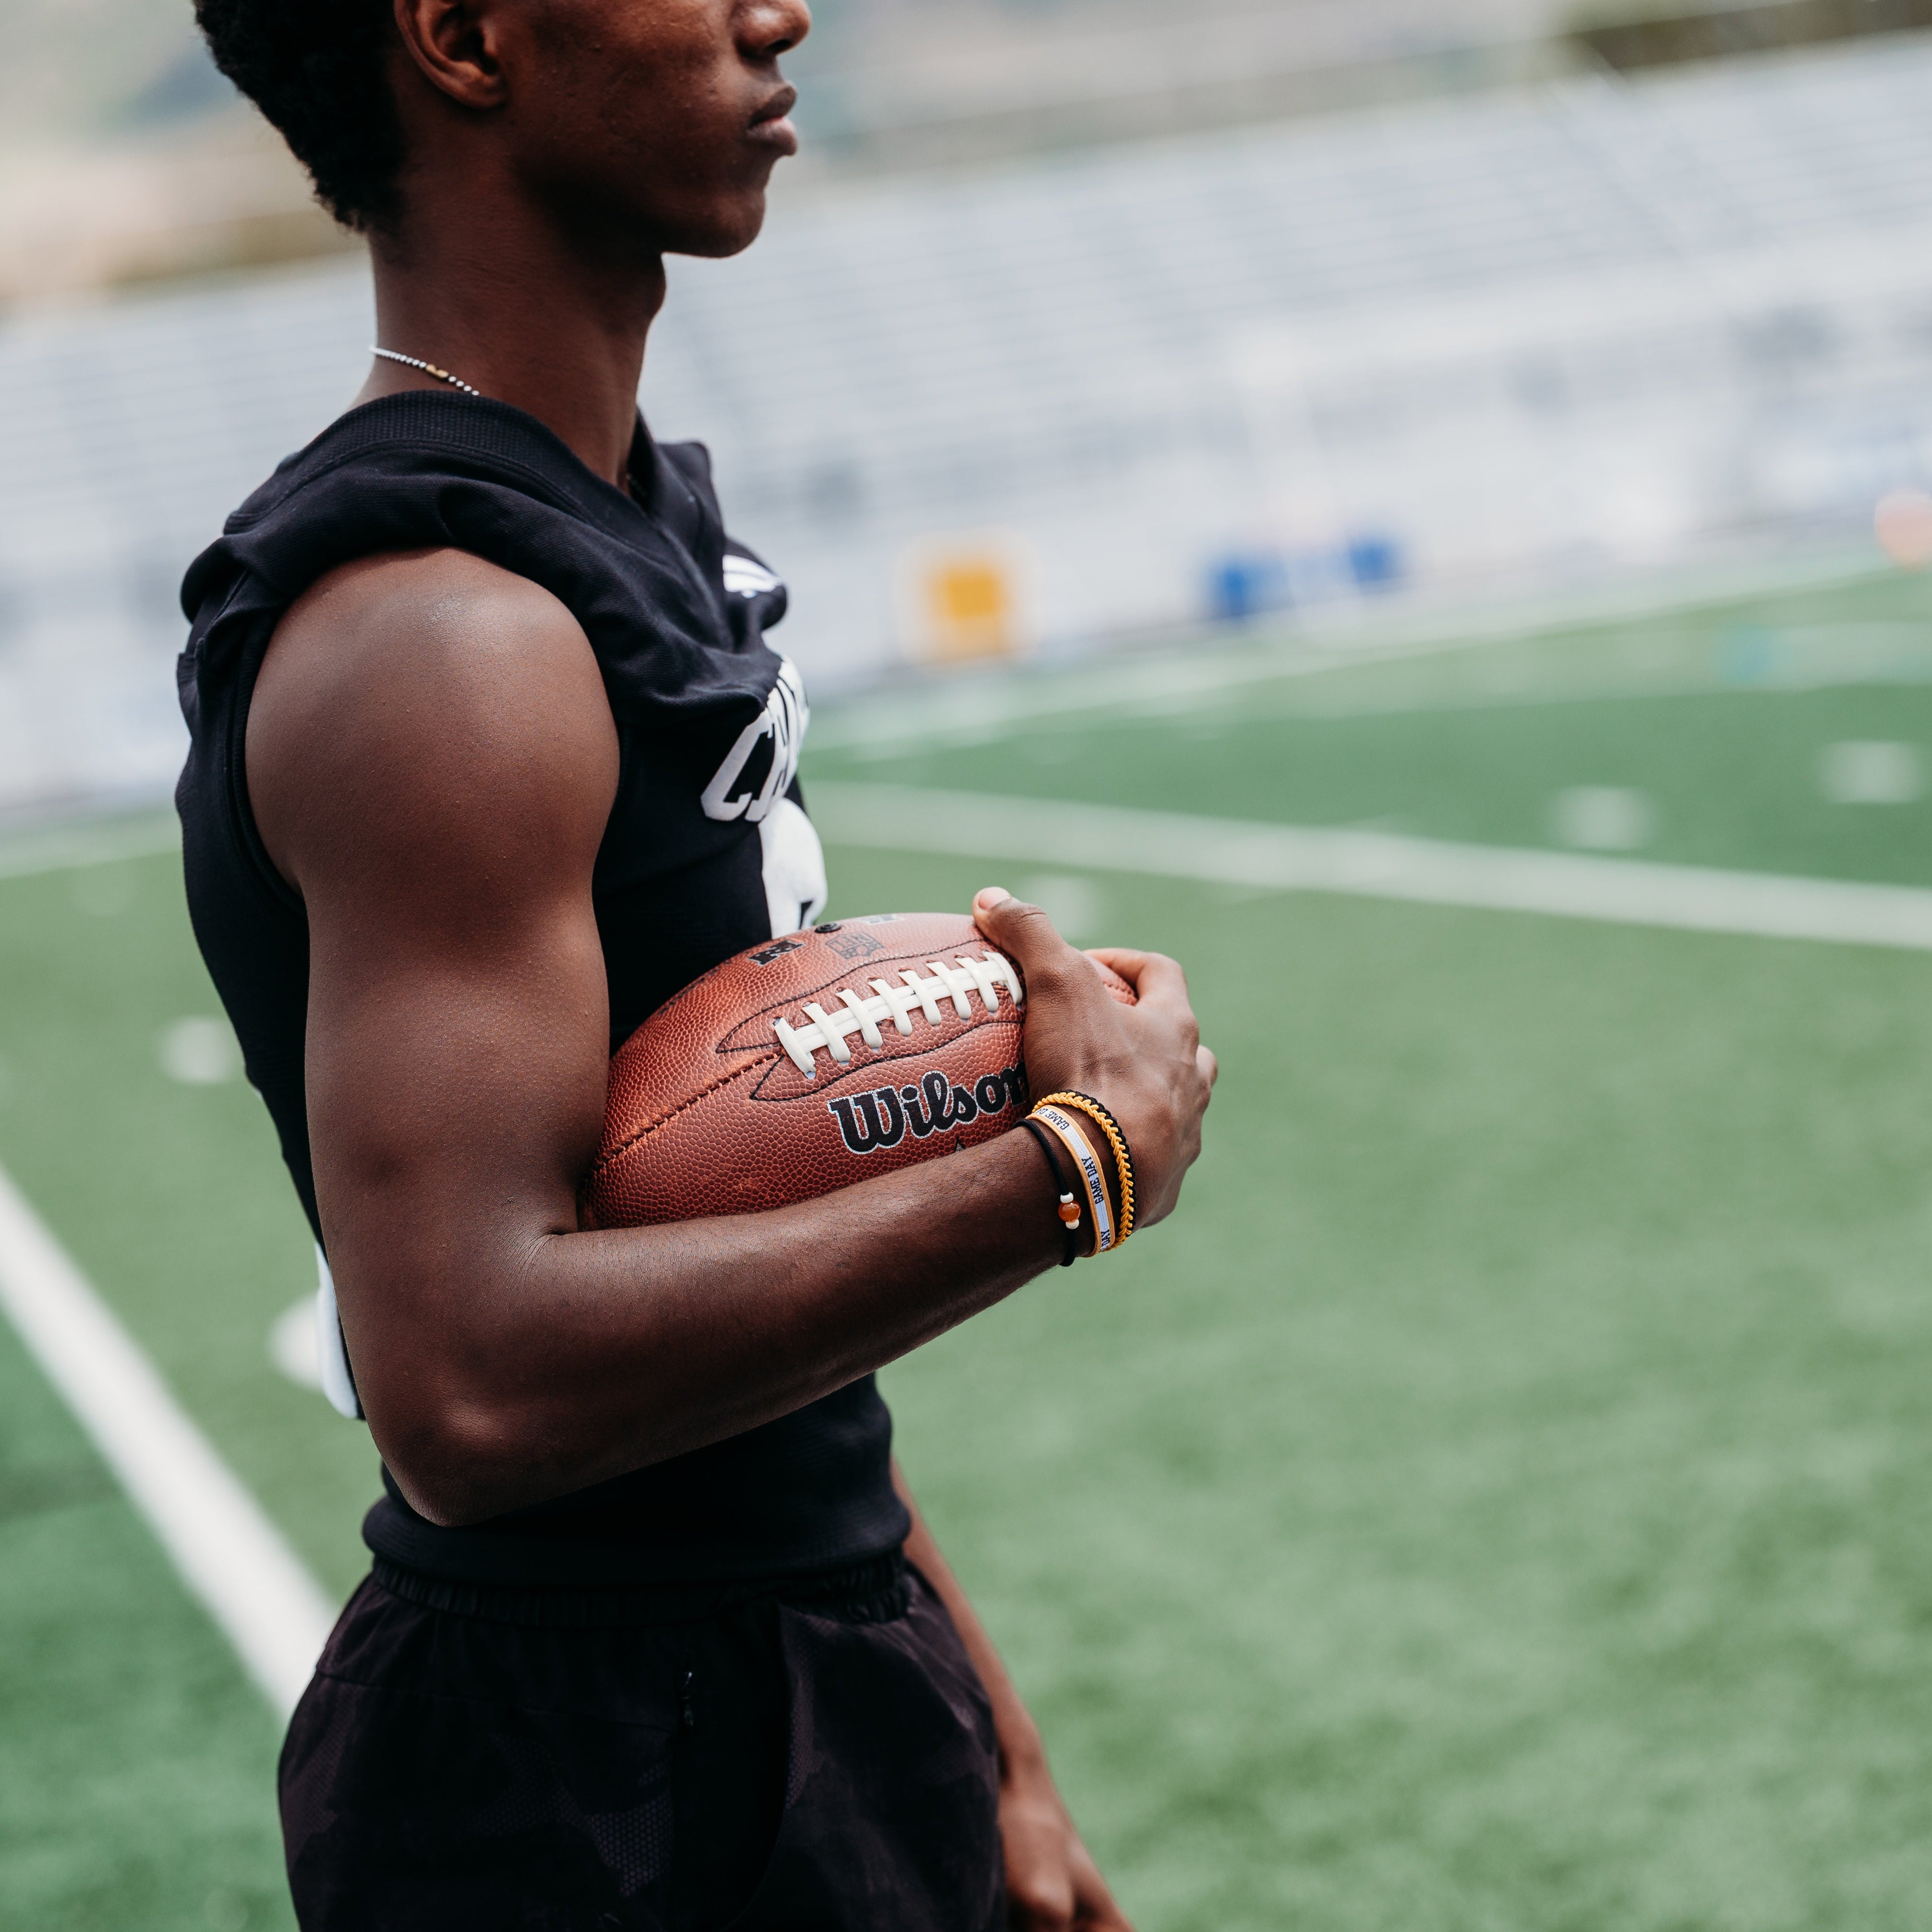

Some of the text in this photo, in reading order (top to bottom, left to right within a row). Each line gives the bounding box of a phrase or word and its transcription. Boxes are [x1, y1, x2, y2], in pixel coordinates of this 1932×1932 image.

[827, 1060, 1028, 1155] Wilson
[1045, 1111, 1070, 1130] GAME
[1081, 1156, 1104, 1204] GAME DAY
